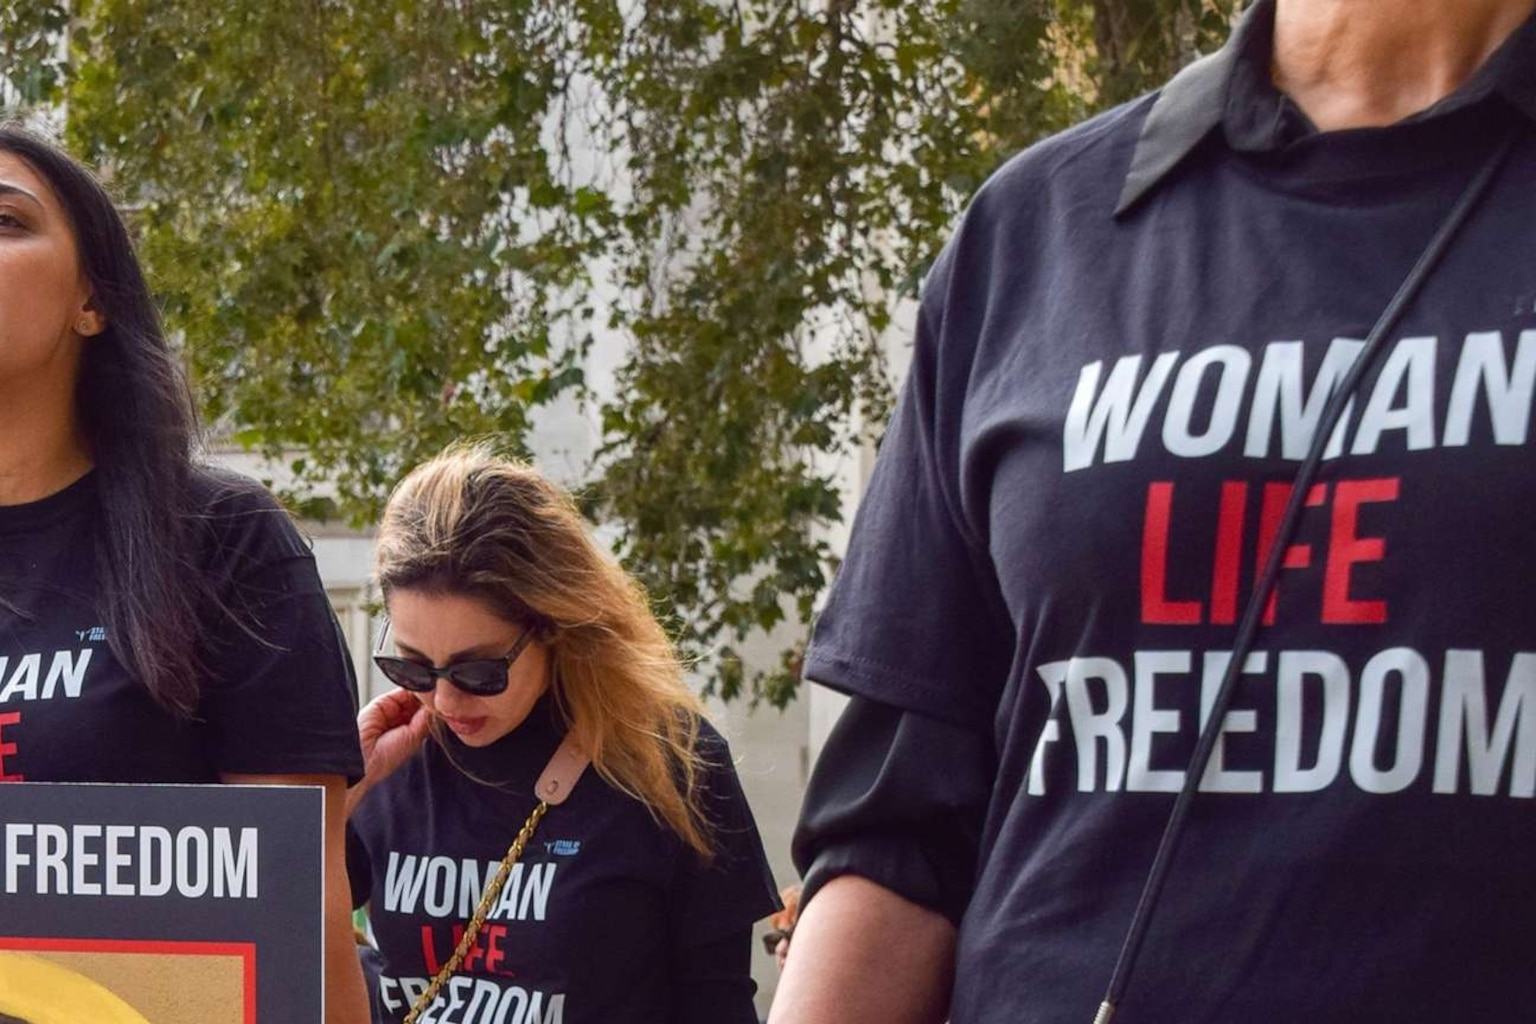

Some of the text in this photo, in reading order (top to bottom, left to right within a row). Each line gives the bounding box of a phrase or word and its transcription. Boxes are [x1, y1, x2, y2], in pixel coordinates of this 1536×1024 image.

[1063, 329, 1536, 473] WOMAN
[1140, 478, 1401, 626] LIFE
[1028, 647, 1536, 798] FREEDOM
[5, 823, 258, 899] FREEDOM
[384, 851, 557, 921] WOMAN
